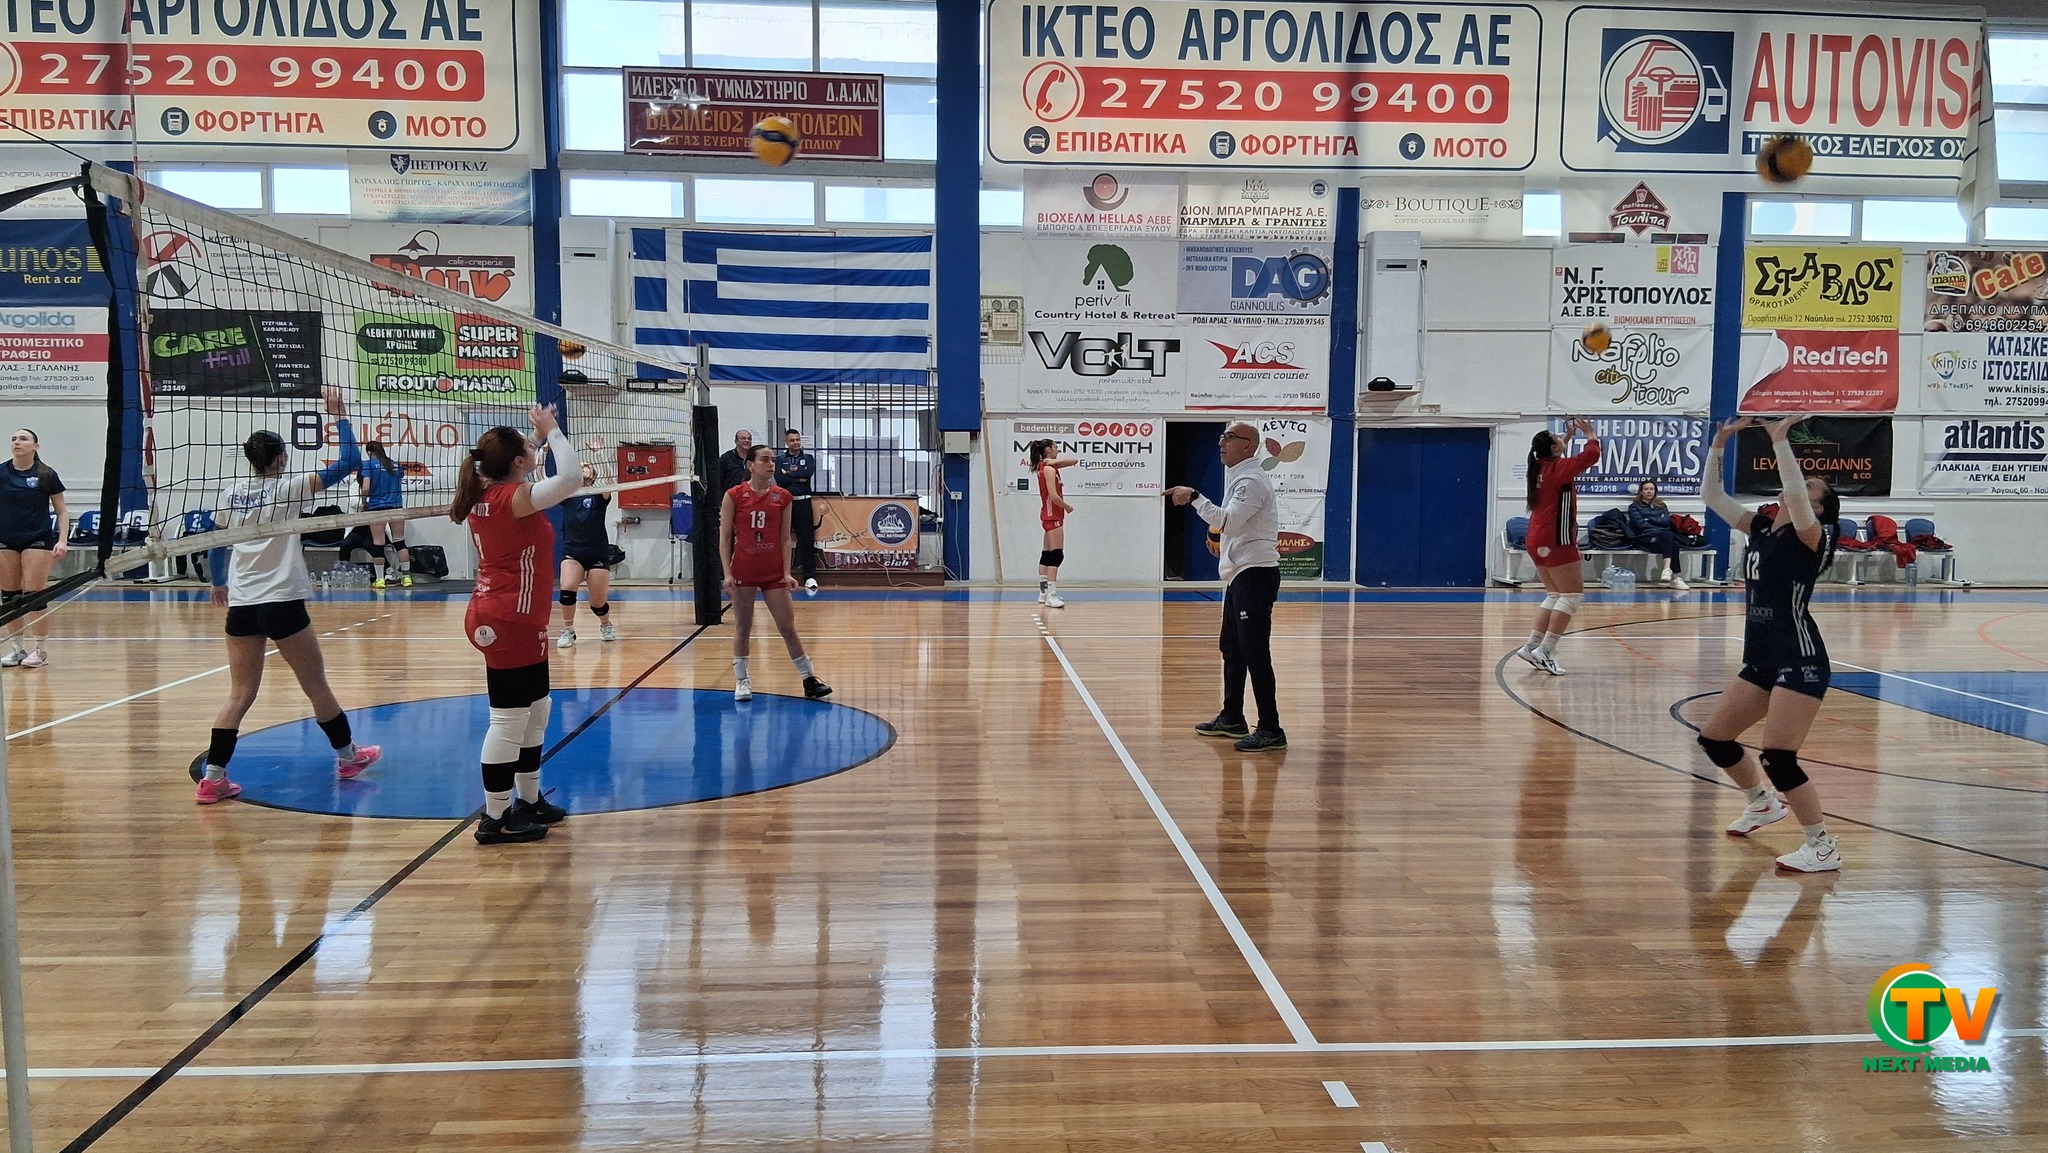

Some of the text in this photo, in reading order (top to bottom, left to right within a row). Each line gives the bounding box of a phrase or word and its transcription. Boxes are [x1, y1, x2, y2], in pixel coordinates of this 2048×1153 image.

[421, 0, 482, 41] ΑΕ
[1022, 5, 1512, 66] ΙΚΤΕΟ ΑΡΓΟΛΙΔΟΣ ΑΕ
[40, 53, 467, 92] 27520 99400
[704, 78, 808, 101] ΓΥΜΝΑΣΤΗΡΙΟ
[826, 82, 878, 103] Δ.Α.Κ.Ν.
[1100, 78, 1493, 115] 27520 99400
[195, 110, 325, 134] ΦΟΡΤΗΓΑ
[406, 116, 486, 138] ΜΟΤΟ
[645, 107, 744, 133] ΒΑΣΙΛΕΙΟΣ
[1056, 131, 1508, 159] ΕΠΙΒΑΤΙΚΑ ΦΟΡΤΗΓΑ ΜΟΤΟ
[1848, 137, 1935, 158] ΕΛΕΓΧΟΣ
[411, 159, 488, 173] ΠΕΤΡΟΓΚΑΖ
[1180, 206, 1328, 217] ΔΙΟΝ. ΜΠΑΡΜΠΑΡΗΣ Α.Ε.
[1395, 196, 1491, 214] BOUTIQUE
[1099, 213, 1143, 224] HELLAS
[1180, 217, 1327, 227] ΜΑΡΜΑΡΑ & ΓΡΑΝΙΤΕΣ
[23, 274, 82, 284] Rent a car
[1563, 267, 1604, 285] Ν. Γ.
[1973, 252, 2044, 298] Cafe
[1562, 287, 1712, 305] ΧΡΙΣΤΟΠΟΥΛΟΣ
[1035, 310, 1176, 320] Country Hotel & Retreat
[1230, 301, 1285, 311] GIANNOULIS
[1561, 306, 1610, 317] Α.Ε.Β.Ε.
[1930, 305, 1997, 315] ΔΡΕΠΑΝΟ
[1613, 316, 1654, 324] ΒΙΟΜΗΧΑΝΙΑ
[1804, 314, 1834, 323] Ναύπλιο
[1848, 315, 1865, 323] 2752
[1866, 315, 1893, 323] 306702
[1966, 319, 2044, 331] 6948602254
[154, 327, 247, 357] CARE
[458, 325, 520, 342] SUPER
[458, 345, 520, 358] MARKET
[1027, 331, 1181, 378] VOLT
[1231, 341, 1296, 365] ACS
[1987, 336, 2048, 356] ΚΑΤΑΣΚΕ
[1793, 345, 1888, 366] RedTech
[1935, 356, 1978, 370] kinisis
[1229, 370, 1310, 381] σημαίνει courier
[1632, 382, 1690, 406] tour
[1984, 397, 2002, 407] τηλ.
[1020, 423, 1069, 434] bedeniti.gr
[1944, 420, 2045, 450] atlantis
[1992, 464, 2015, 472] ΕΙΔΗ
[1969, 474, 2000, 482] ΛΕΥΚΑ
[1590, 484, 1618, 493] 122018
[750, 510, 766, 529] 13
[1747, 551, 1760, 580] 12
